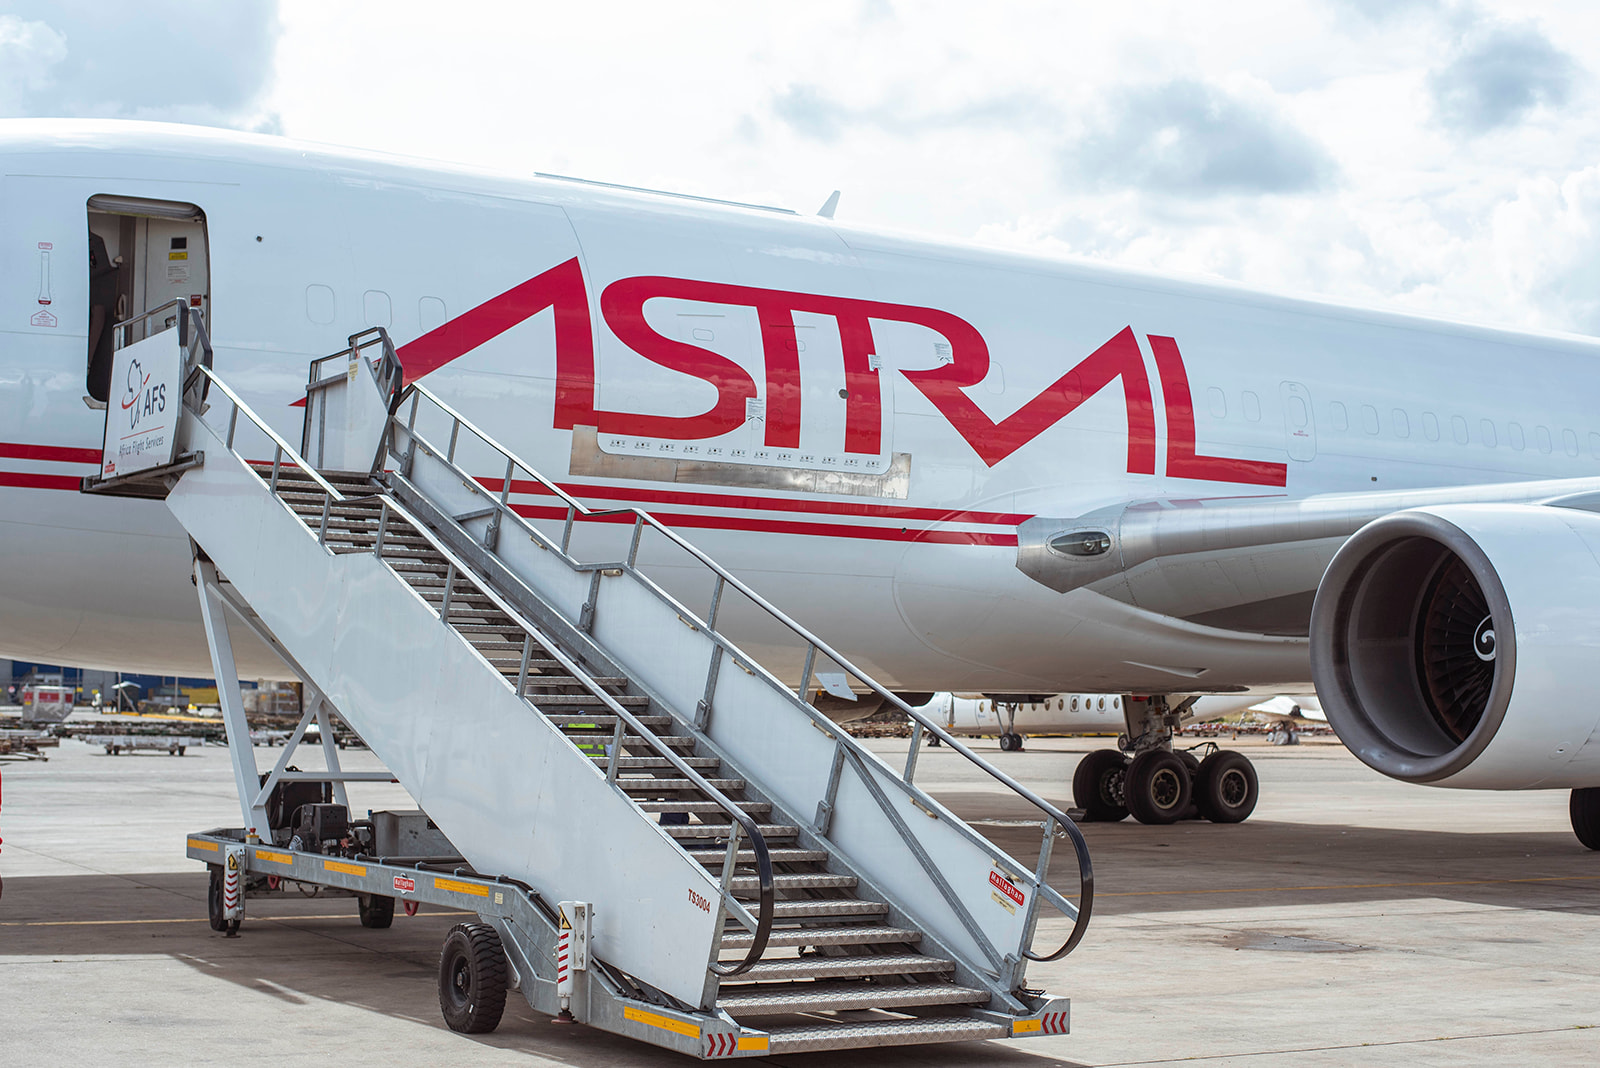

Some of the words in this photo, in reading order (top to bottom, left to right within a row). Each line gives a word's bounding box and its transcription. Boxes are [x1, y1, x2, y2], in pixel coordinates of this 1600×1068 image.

[288, 256, 1287, 487] ASTRAL
[143, 383, 166, 417] AFS
[119, 444, 132, 459] Africa
[132, 440, 145, 455] Flight
[145, 436, 164, 450] Services
[688, 888, 711, 914] TS3004
[990, 872, 1023, 902] Mallaghan
